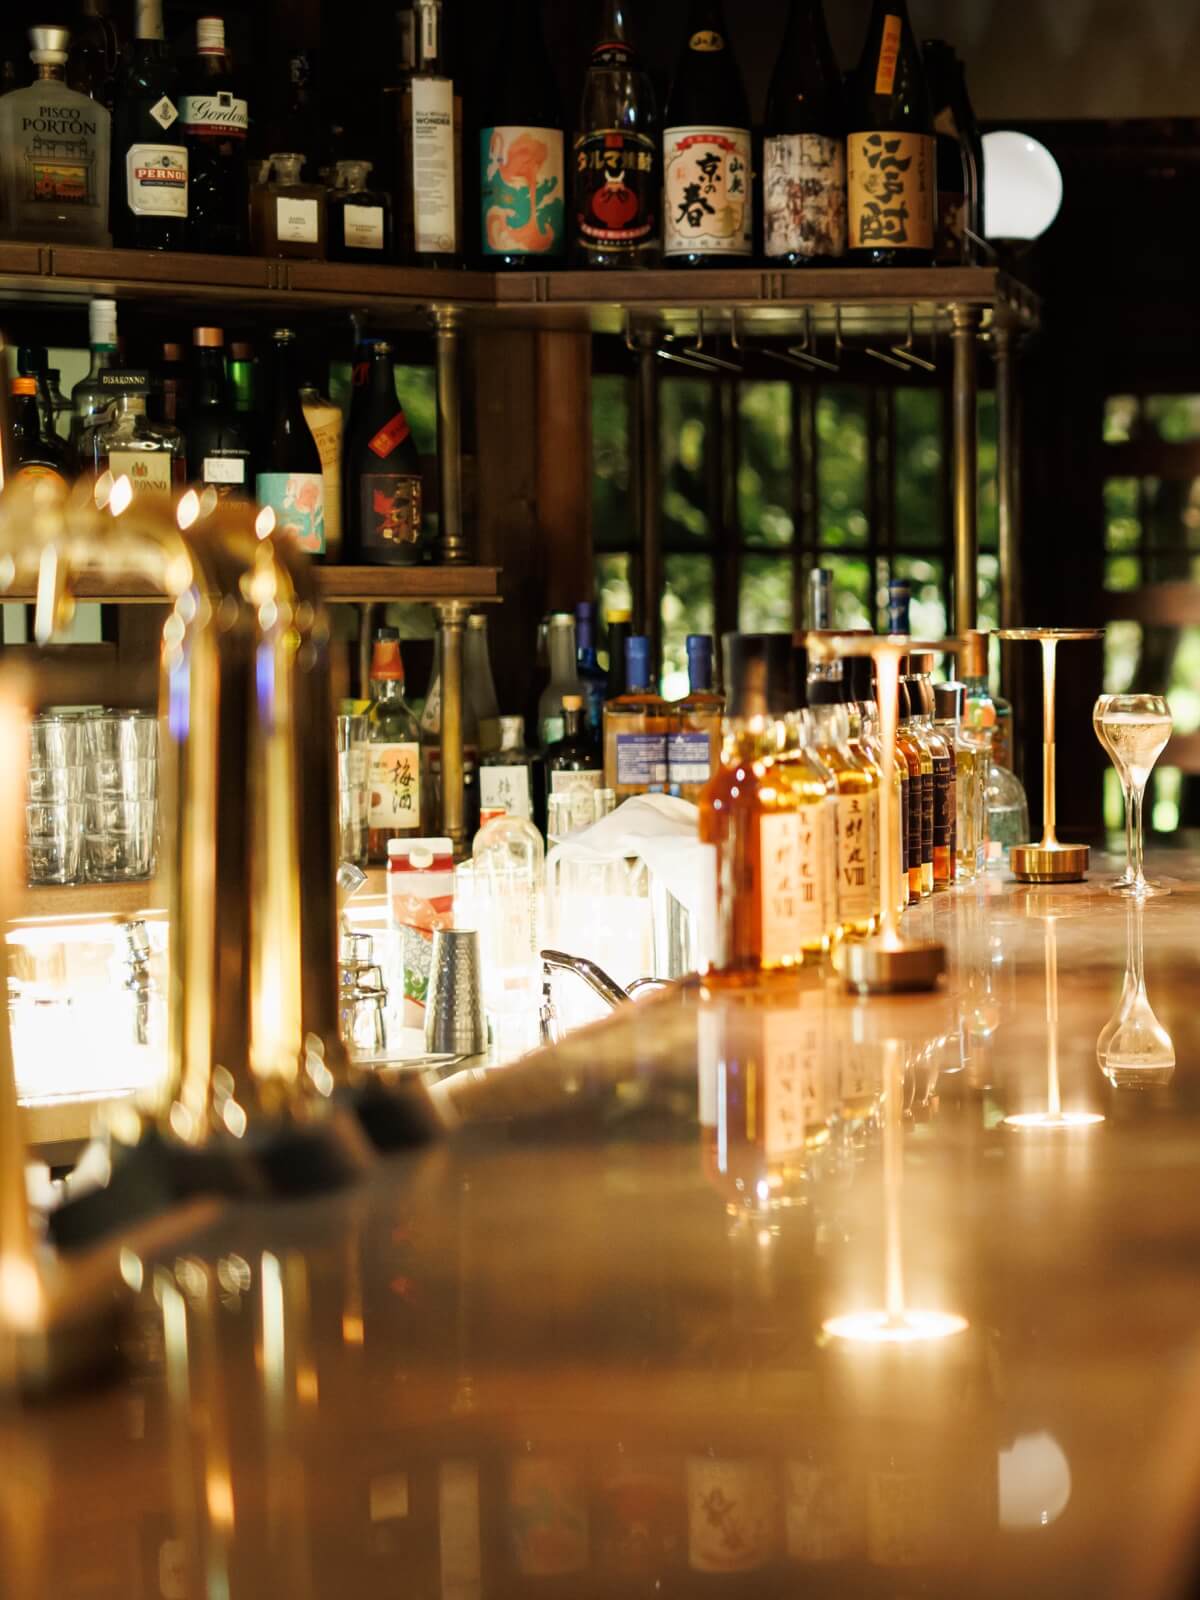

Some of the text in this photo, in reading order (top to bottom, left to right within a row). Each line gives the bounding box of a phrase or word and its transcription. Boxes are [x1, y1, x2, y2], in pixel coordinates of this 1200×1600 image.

[40, 107, 80, 119] PISCO
[676, 152, 722, 228] 京の春
[391, 757, 415, 814] 梅酒
